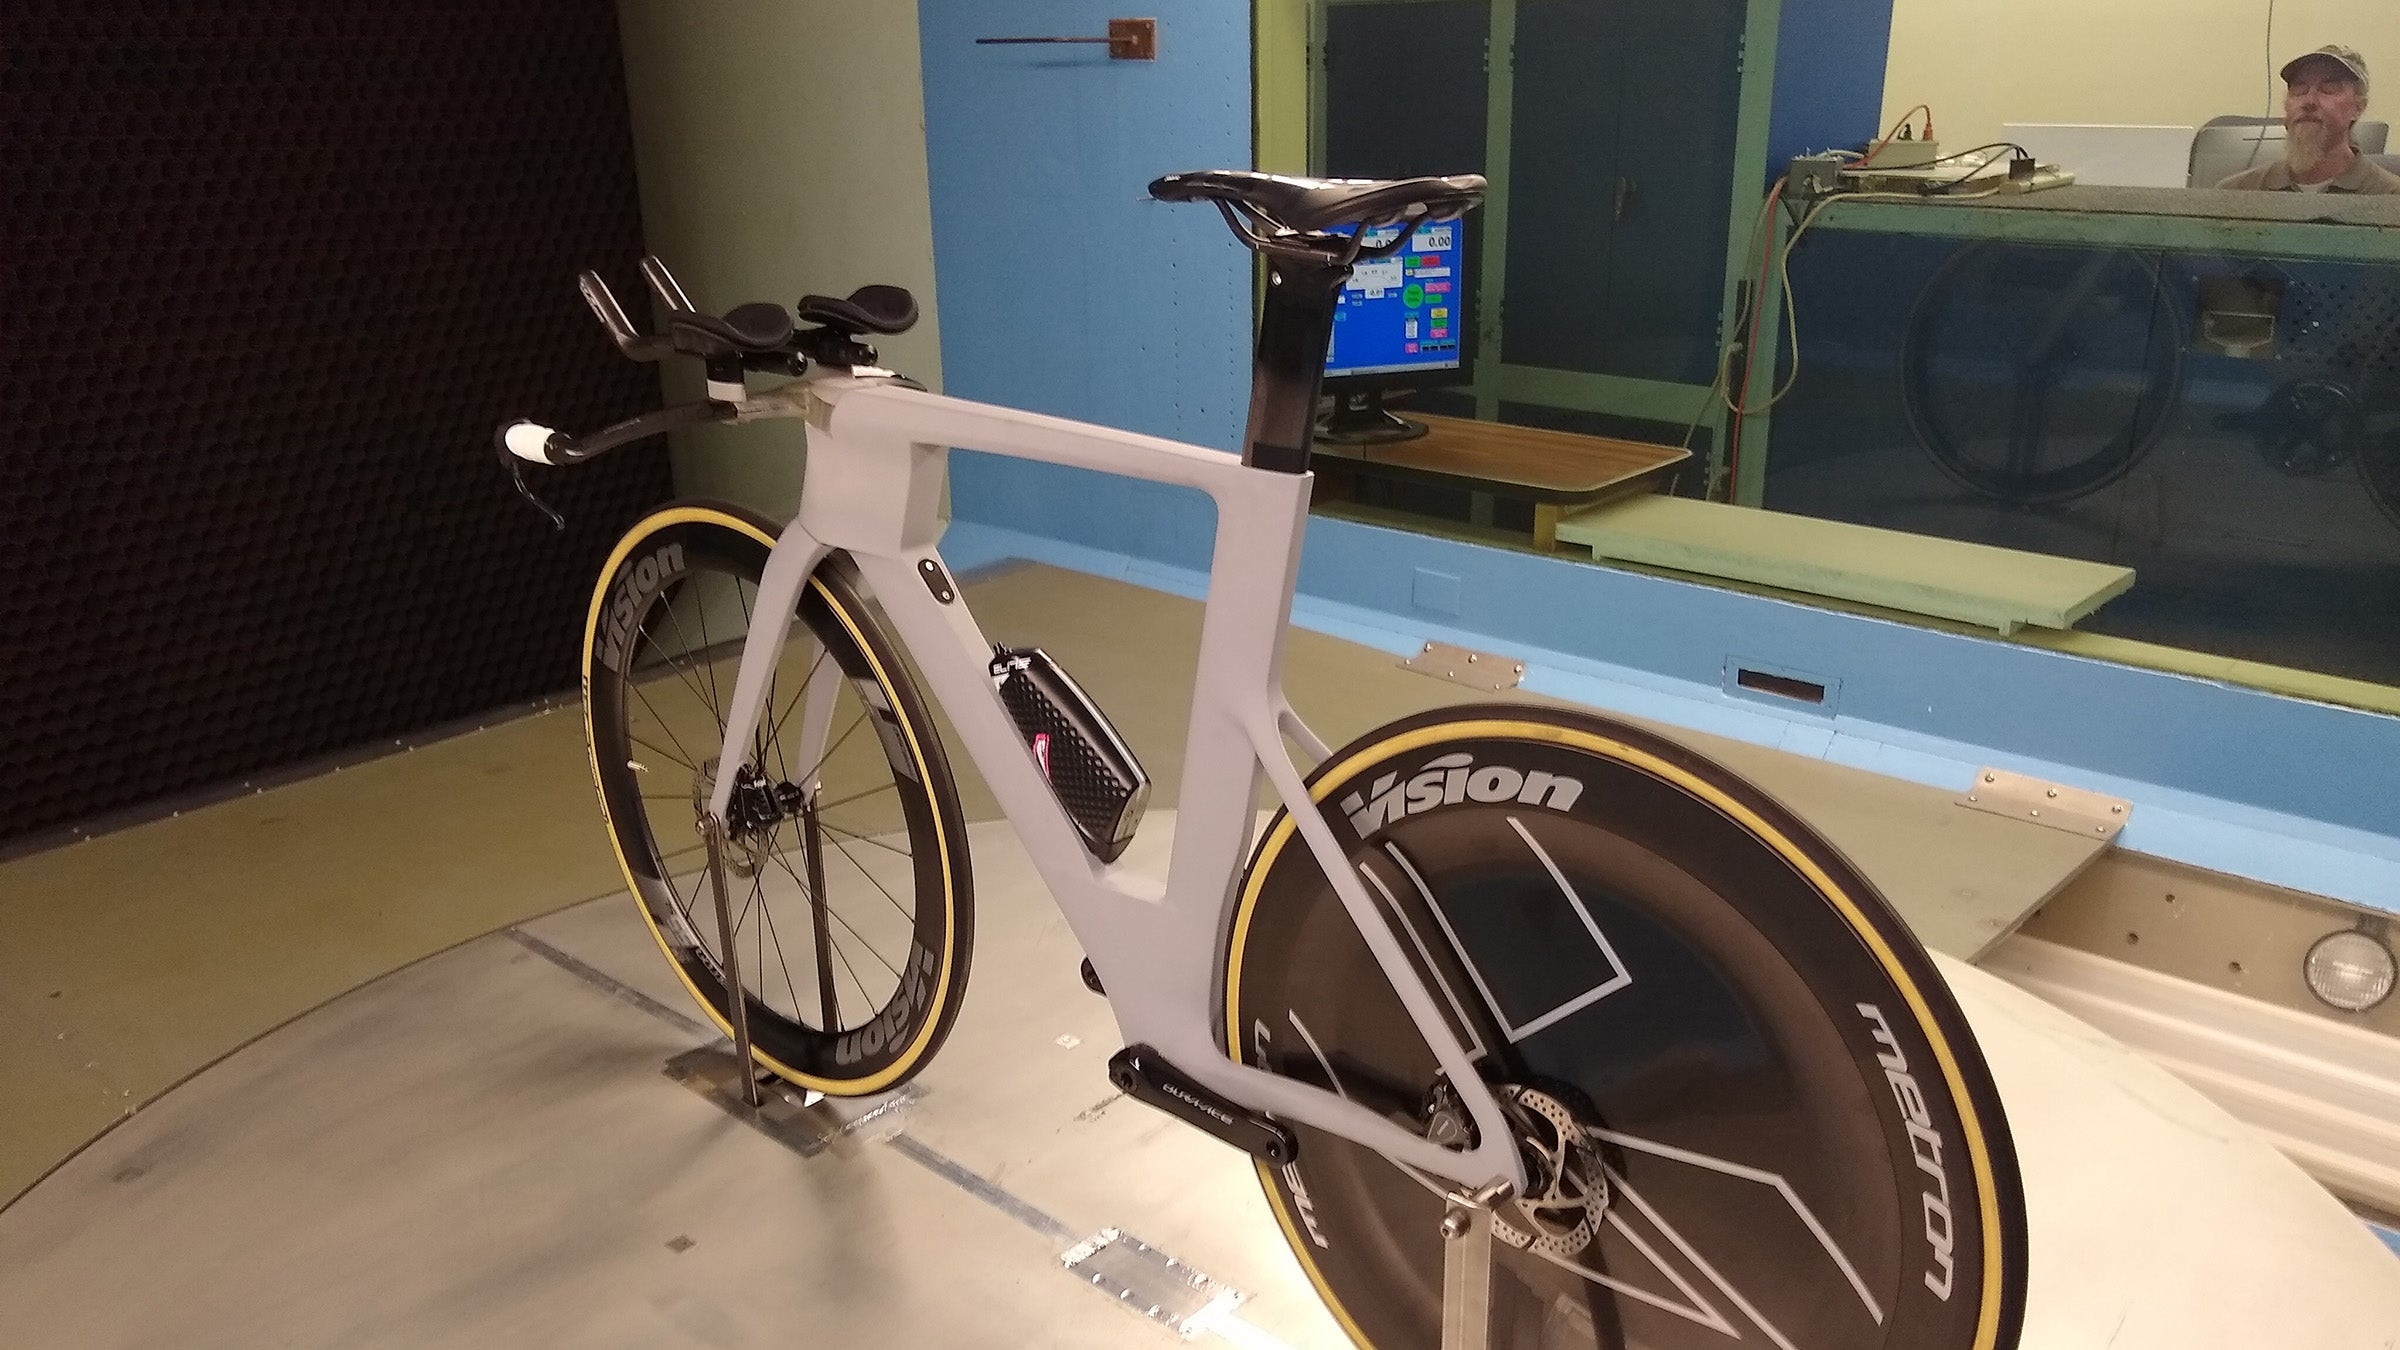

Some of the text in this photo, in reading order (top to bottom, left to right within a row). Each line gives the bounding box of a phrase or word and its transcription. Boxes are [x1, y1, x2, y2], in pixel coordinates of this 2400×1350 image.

[1428, 236, 1451, 248] 0.00
[1339, 752, 1584, 840] Vision
[1855, 1002, 1954, 1302] metron
